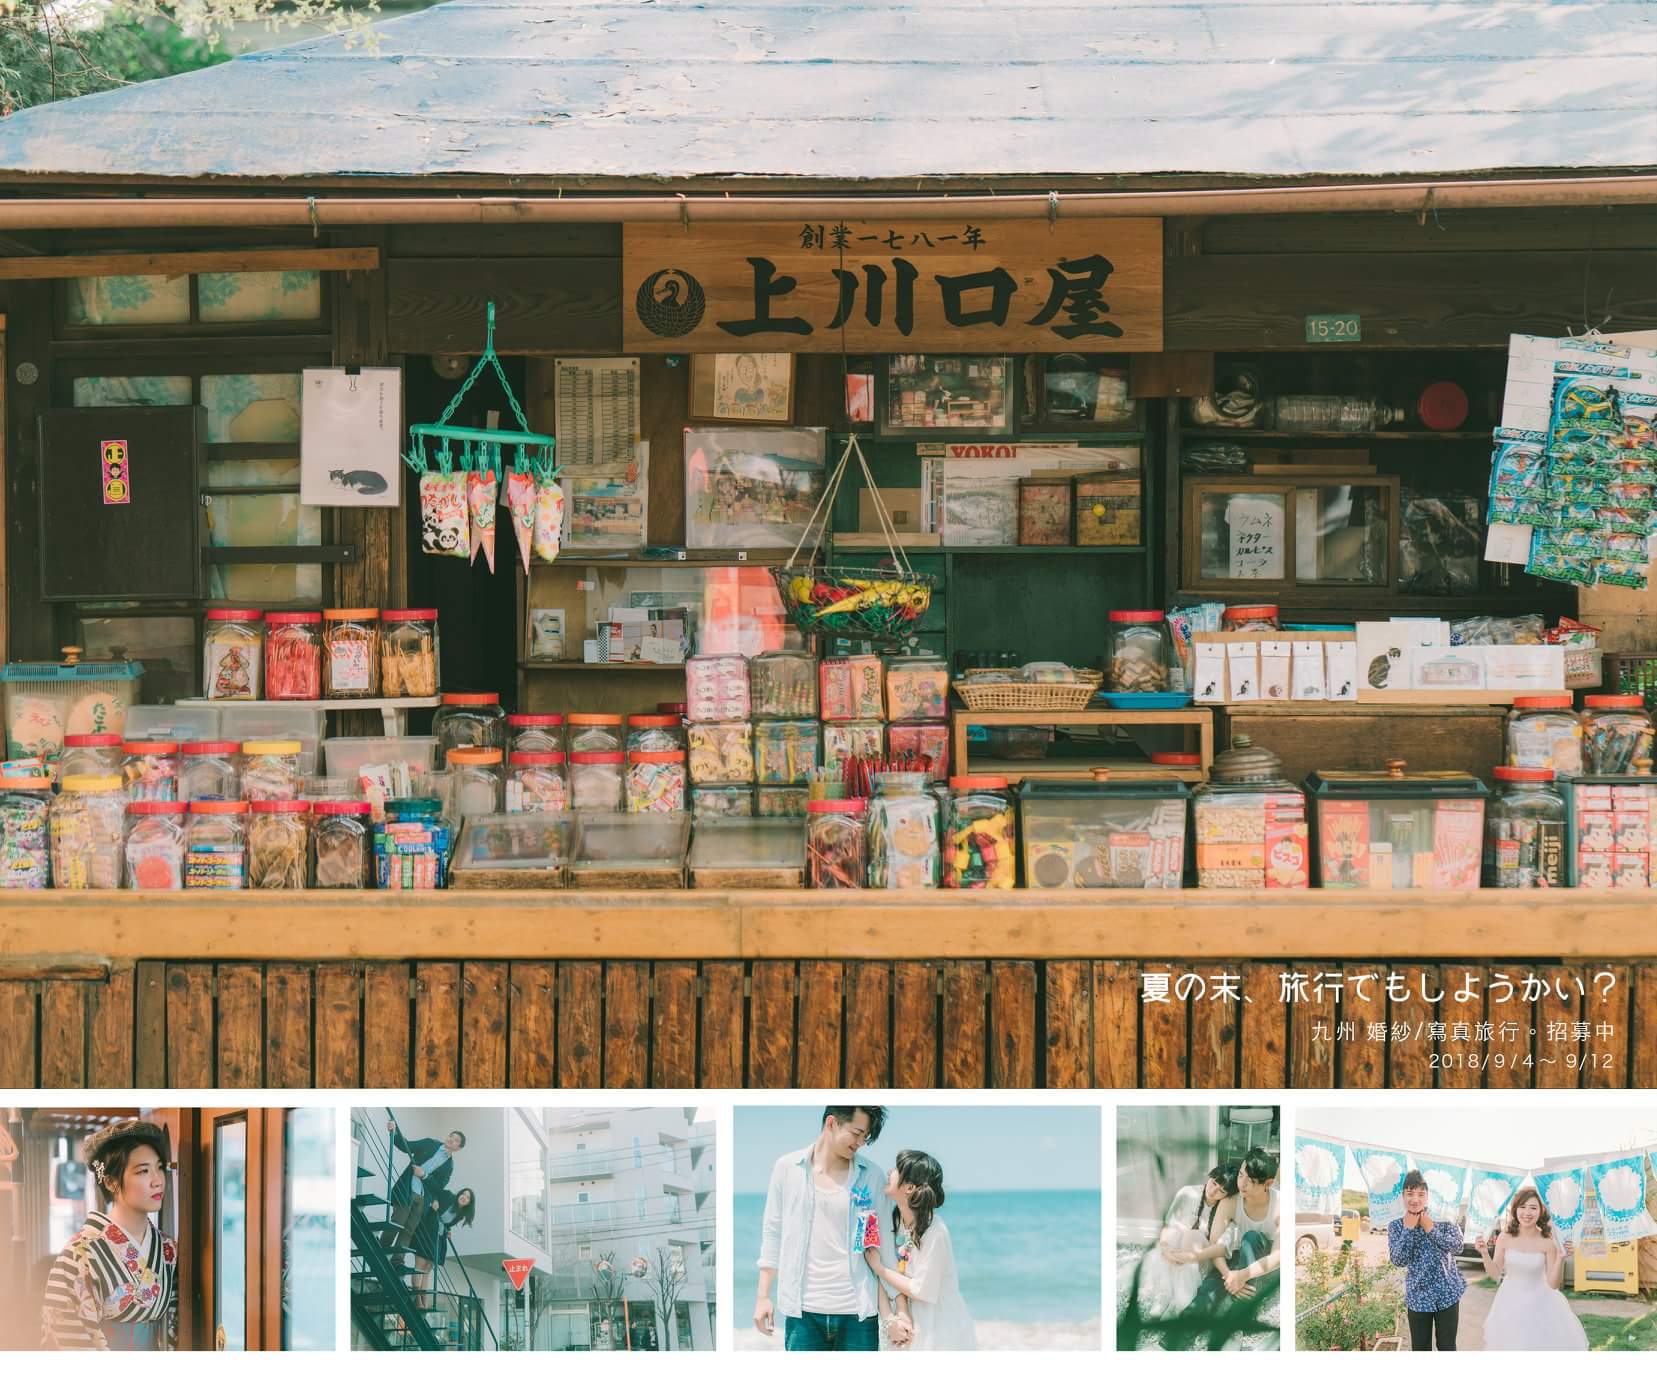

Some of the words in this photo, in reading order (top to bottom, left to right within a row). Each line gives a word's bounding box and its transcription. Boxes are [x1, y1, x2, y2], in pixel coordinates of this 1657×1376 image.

[800, 224, 987, 250] 創業一七八一年
[716, 254, 1124, 340] 上川口屋
[1311, 320, 1358, 336] 15-20
[1274, 848, 1300, 866] ビスコ
[1544, 836, 1562, 884] meiji
[509, 1263, 529, 1273] 止まれ
